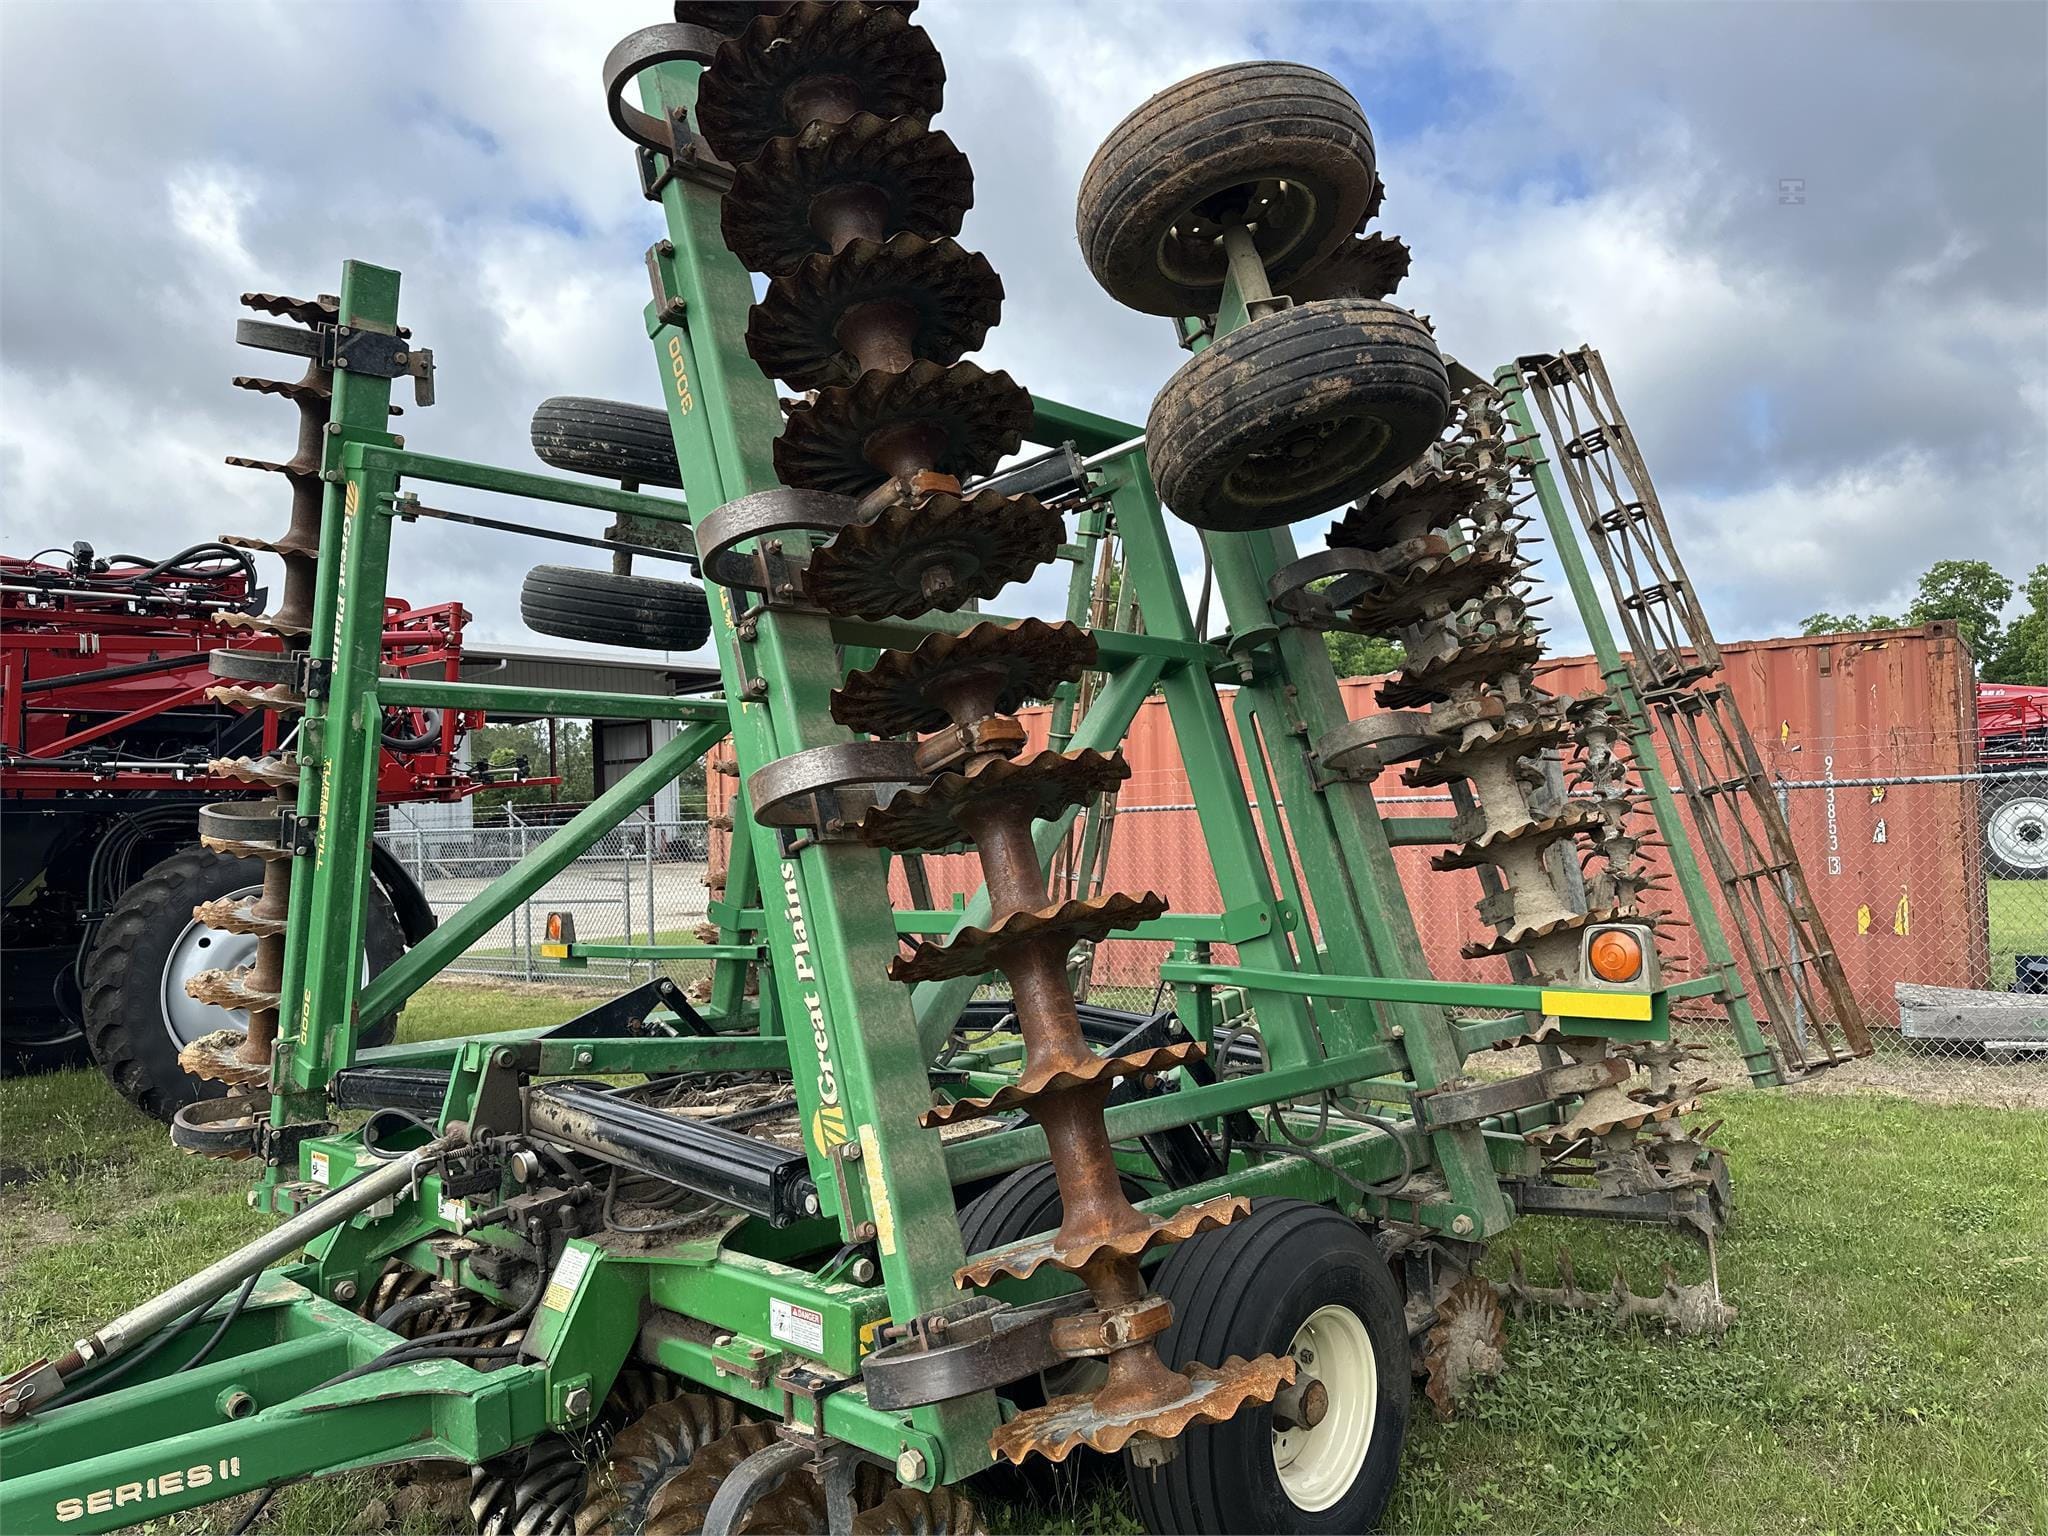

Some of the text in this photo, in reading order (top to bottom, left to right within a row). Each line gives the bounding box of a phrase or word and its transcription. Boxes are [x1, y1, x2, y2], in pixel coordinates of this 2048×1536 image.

[668, 336, 693, 415] 3000
[331, 516, 352, 675] Great Plains
[301, 988, 311, 1046] 3000
[780, 862, 838, 1105] Great Plains
[56, 1464, 213, 1522] SERIES
